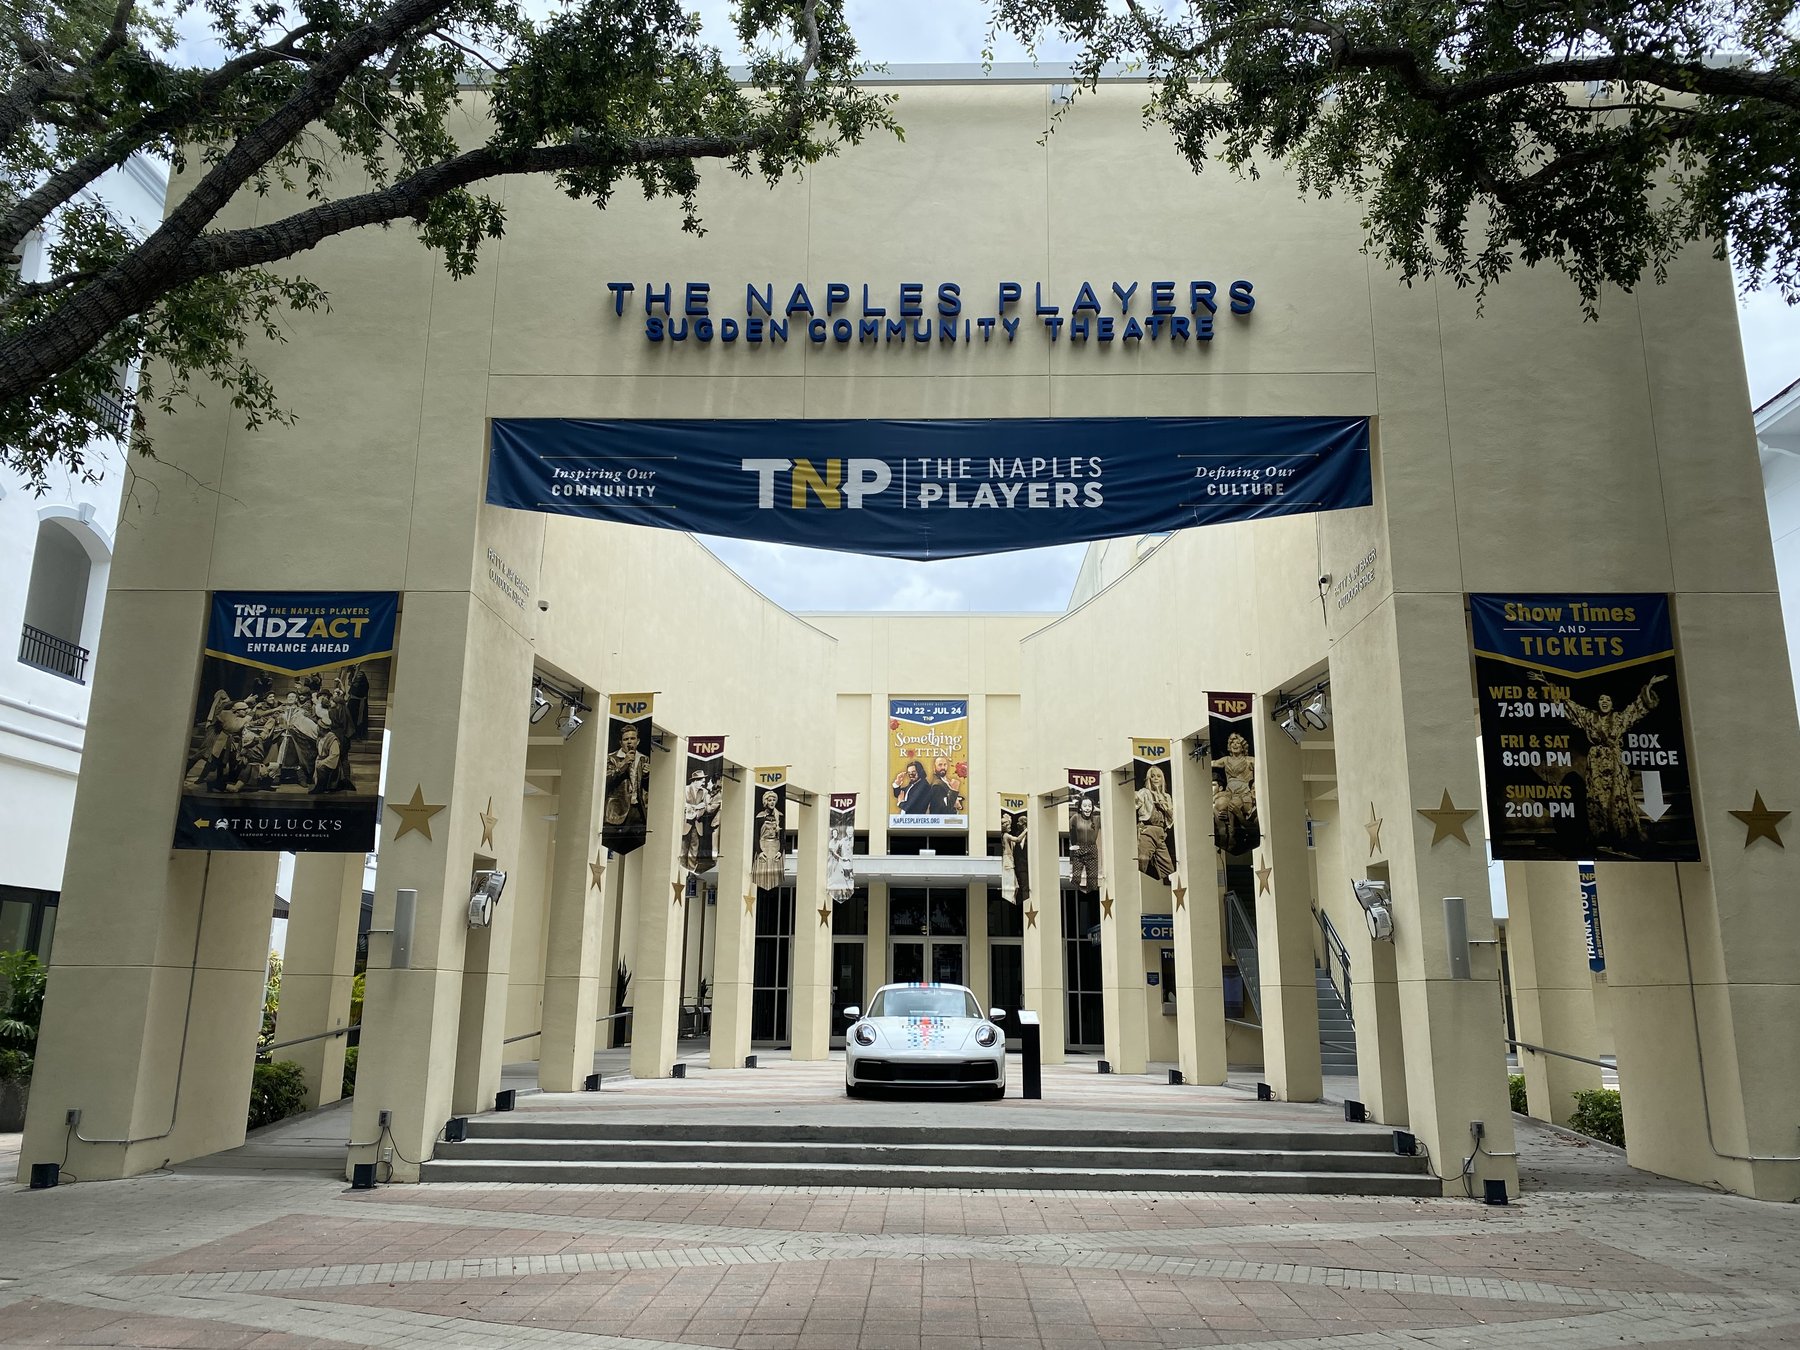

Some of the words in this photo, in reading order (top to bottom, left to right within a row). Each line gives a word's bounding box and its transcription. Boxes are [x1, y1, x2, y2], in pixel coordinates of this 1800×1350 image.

[607, 282, 710, 317] THE
[747, 282, 962, 317] NAPLES
[999, 280, 1255, 316] PLAYERS
[645, 317, 788, 342] SUGDEN
[808, 317, 1020, 342] COMMUNITY
[1044, 316, 1214, 342] THEATRE
[552, 467, 622, 483] Inspiring
[627, 468, 656, 480] Our
[918, 457, 971, 479] THE
[989, 456, 1102, 479] NAPLES
[1194, 465, 1261, 480] Defining
[1265, 466, 1295, 477] Our
[551, 484, 656, 497] COMMUNITY
[741, 458, 892, 509] TNP
[1206, 483, 1284, 496] CULTURE
[917, 481, 1104, 509] PLAYERS
[234, 604, 267, 616] TNP
[270, 607, 287, 615] THE
[290, 607, 326, 615] NAPLES
[330, 607, 370, 615] PLAYERS
[1504, 602, 1562, 622] Show
[1568, 602, 1636, 622] Times
[233, 617, 370, 638] KIDZACT
[1558, 625, 1586, 634] AND
[247, 643, 307, 653] ENTRANCE
[310, 643, 350, 653] AHEAD
[1520, 637, 1624, 656] TICKETS
[1488, 686, 1523, 699] WED
[1527, 686, 1538, 699] &
[1541, 686, 1571, 699] THU
[616, 701, 648, 714] TNP
[1214, 700, 1247, 713] TNP
[1498, 702, 1534, 718] 7:30
[1539, 702, 1565, 718] PM
[894, 728, 962, 751] Something
[1501, 735, 1524, 748] FRI
[1529, 735, 1540, 748] &
[1544, 735, 1570, 748] SAT
[1628, 734, 1661, 749] BOX
[693, 742, 720, 753] TNP
[1138, 745, 1165, 757] TNP
[1502, 751, 1541, 767] 8:00
[1546, 751, 1571, 767] PM
[1621, 750, 1679, 766] OFFICE
[760, 773, 782, 782] TNP
[1072, 775, 1096, 786] TNP
[1505, 785, 1572, 799] SUNDAYS
[833, 798, 853, 807] TNP
[1004, 798, 1024, 808] TNP
[1505, 801, 1543, 818] 2:00
[1550, 802, 1575, 818] PM
[231, 818, 342, 830] TRULUCK'S
[1580, 892, 1590, 915] YOU
[1583, 919, 1596, 959] THANK
